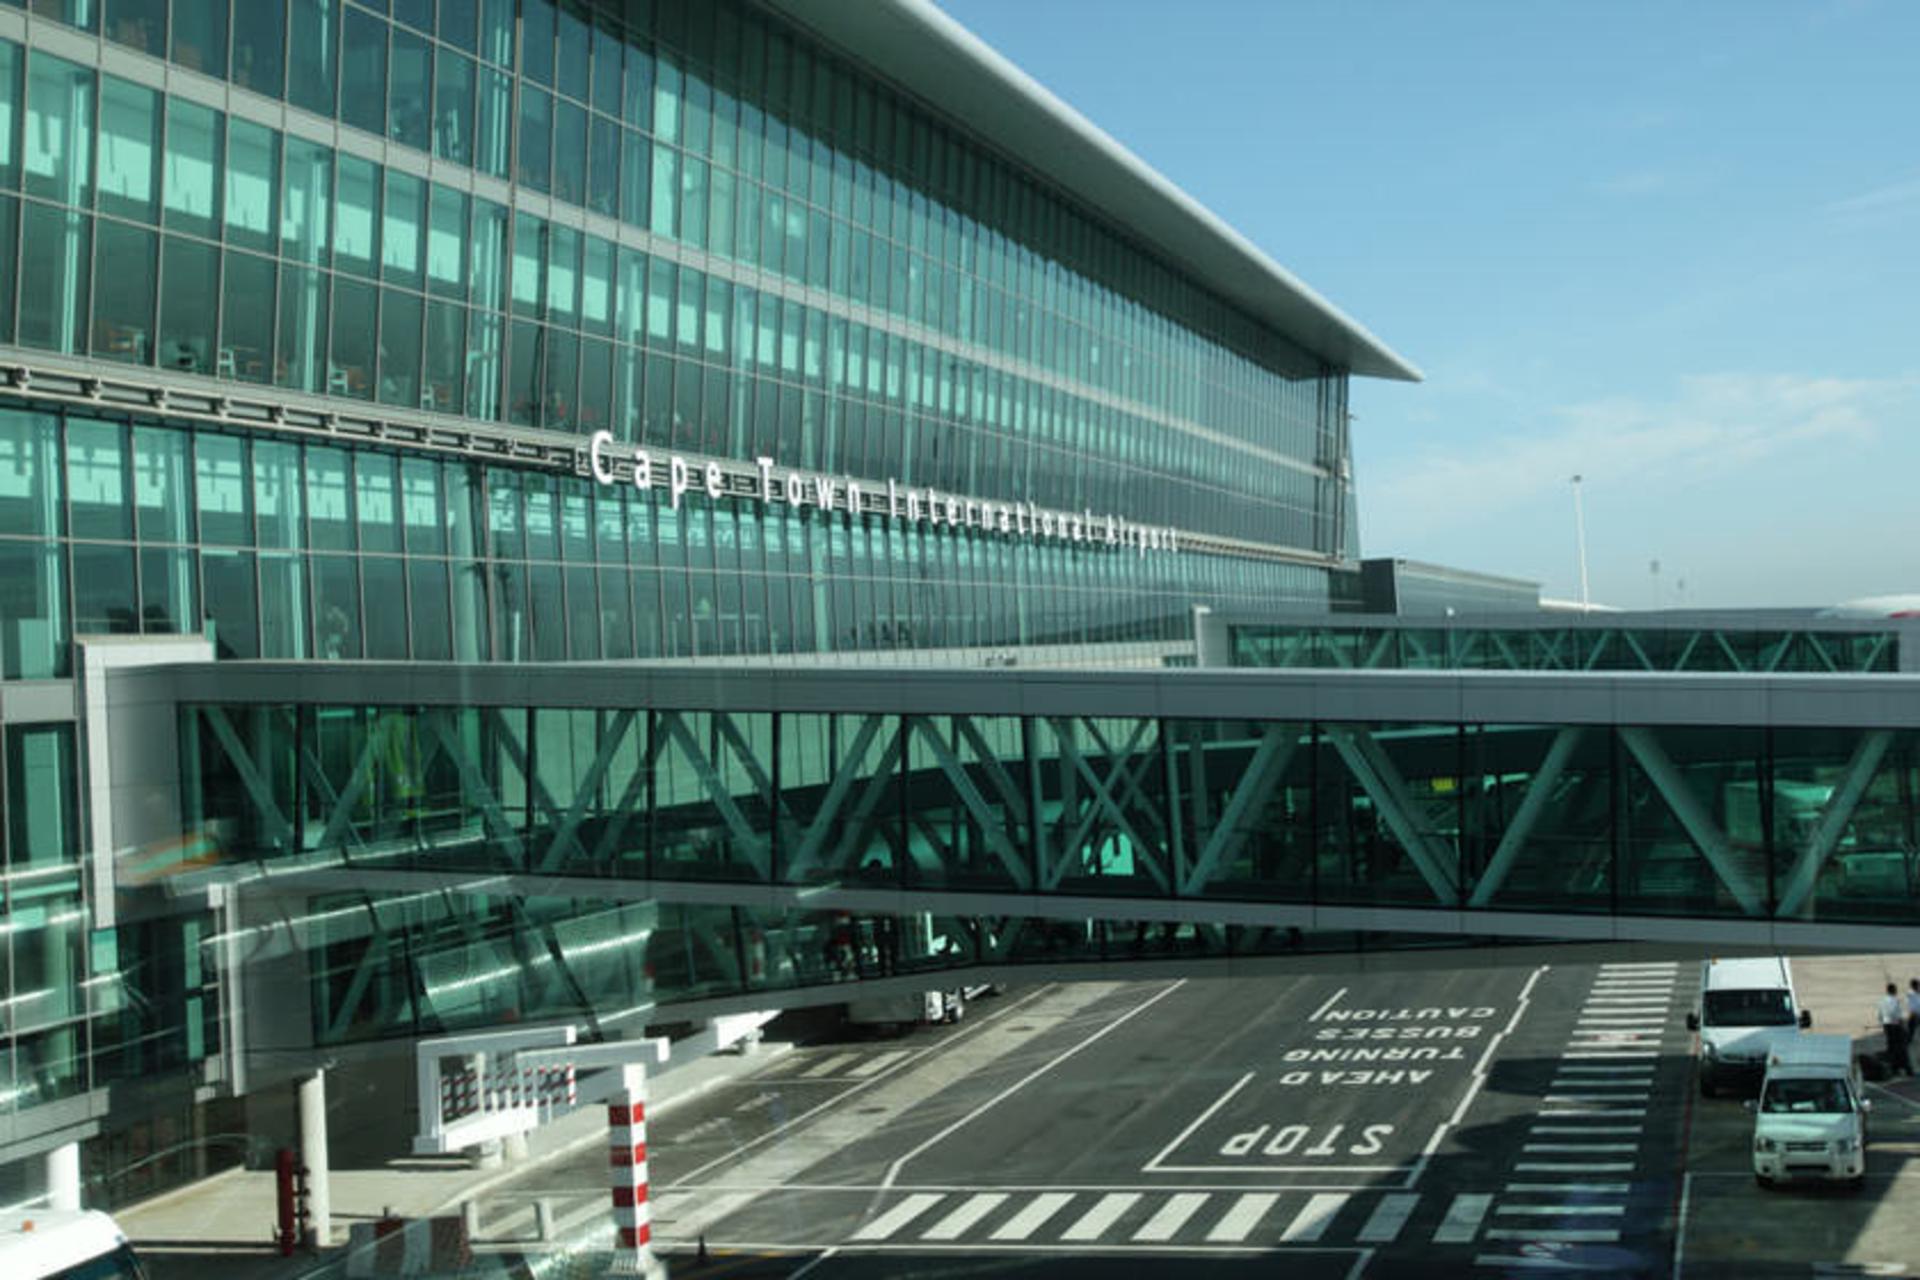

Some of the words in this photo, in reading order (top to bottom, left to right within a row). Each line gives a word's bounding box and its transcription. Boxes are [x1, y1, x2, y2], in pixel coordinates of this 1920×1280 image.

[591, 429, 722, 510] Cape
[757, 456, 861, 514] Town
[889, 477, 1092, 542] International
[1106, 513, 1178, 560] Airport
[1324, 1007, 1496, 1021] CAUTION
[1315, 1026, 1482, 1040] BUSSES
[1282, 1047, 1466, 1062] TURNING
[1279, 1069, 1434, 1085] AHEAD
[1219, 1124, 1395, 1156] STOP
